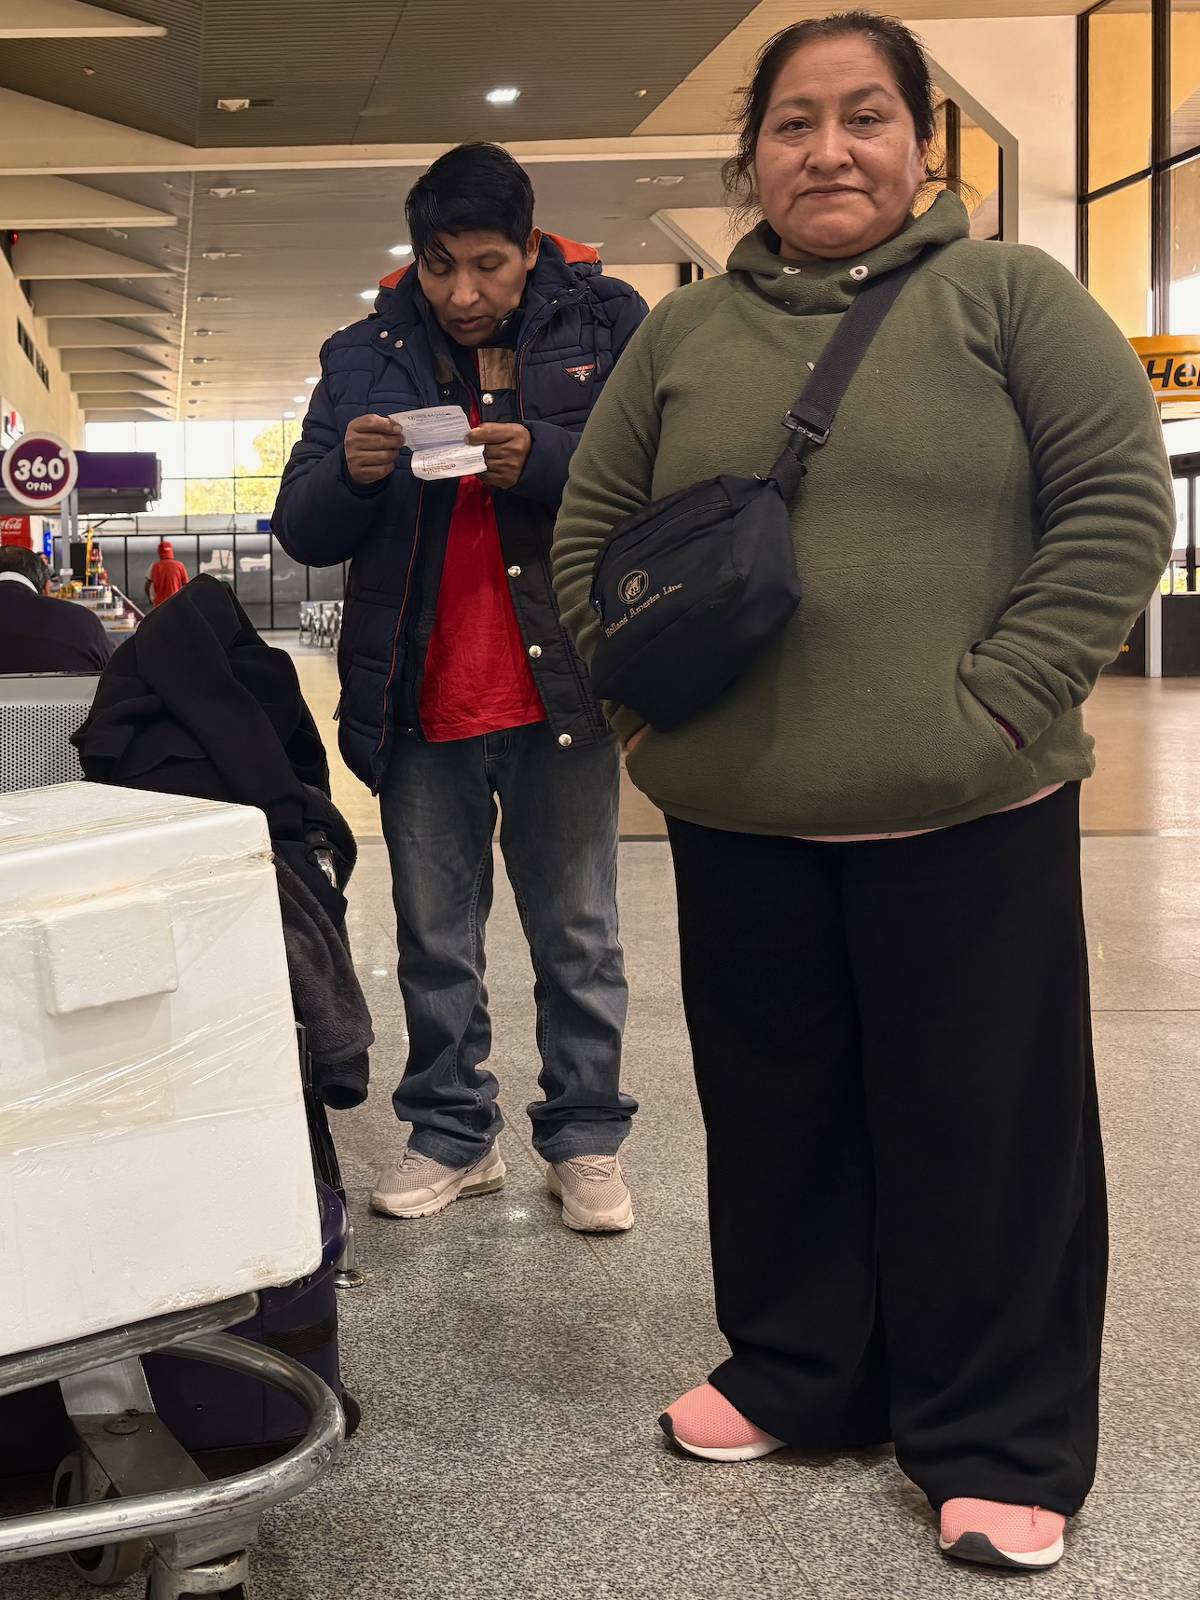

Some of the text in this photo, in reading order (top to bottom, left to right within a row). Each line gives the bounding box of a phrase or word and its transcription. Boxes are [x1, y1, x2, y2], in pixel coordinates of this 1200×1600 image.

[1147, 358, 1200, 388] He
[26, 481, 53, 492] OPEN
[661, 582, 684, 596] Line
